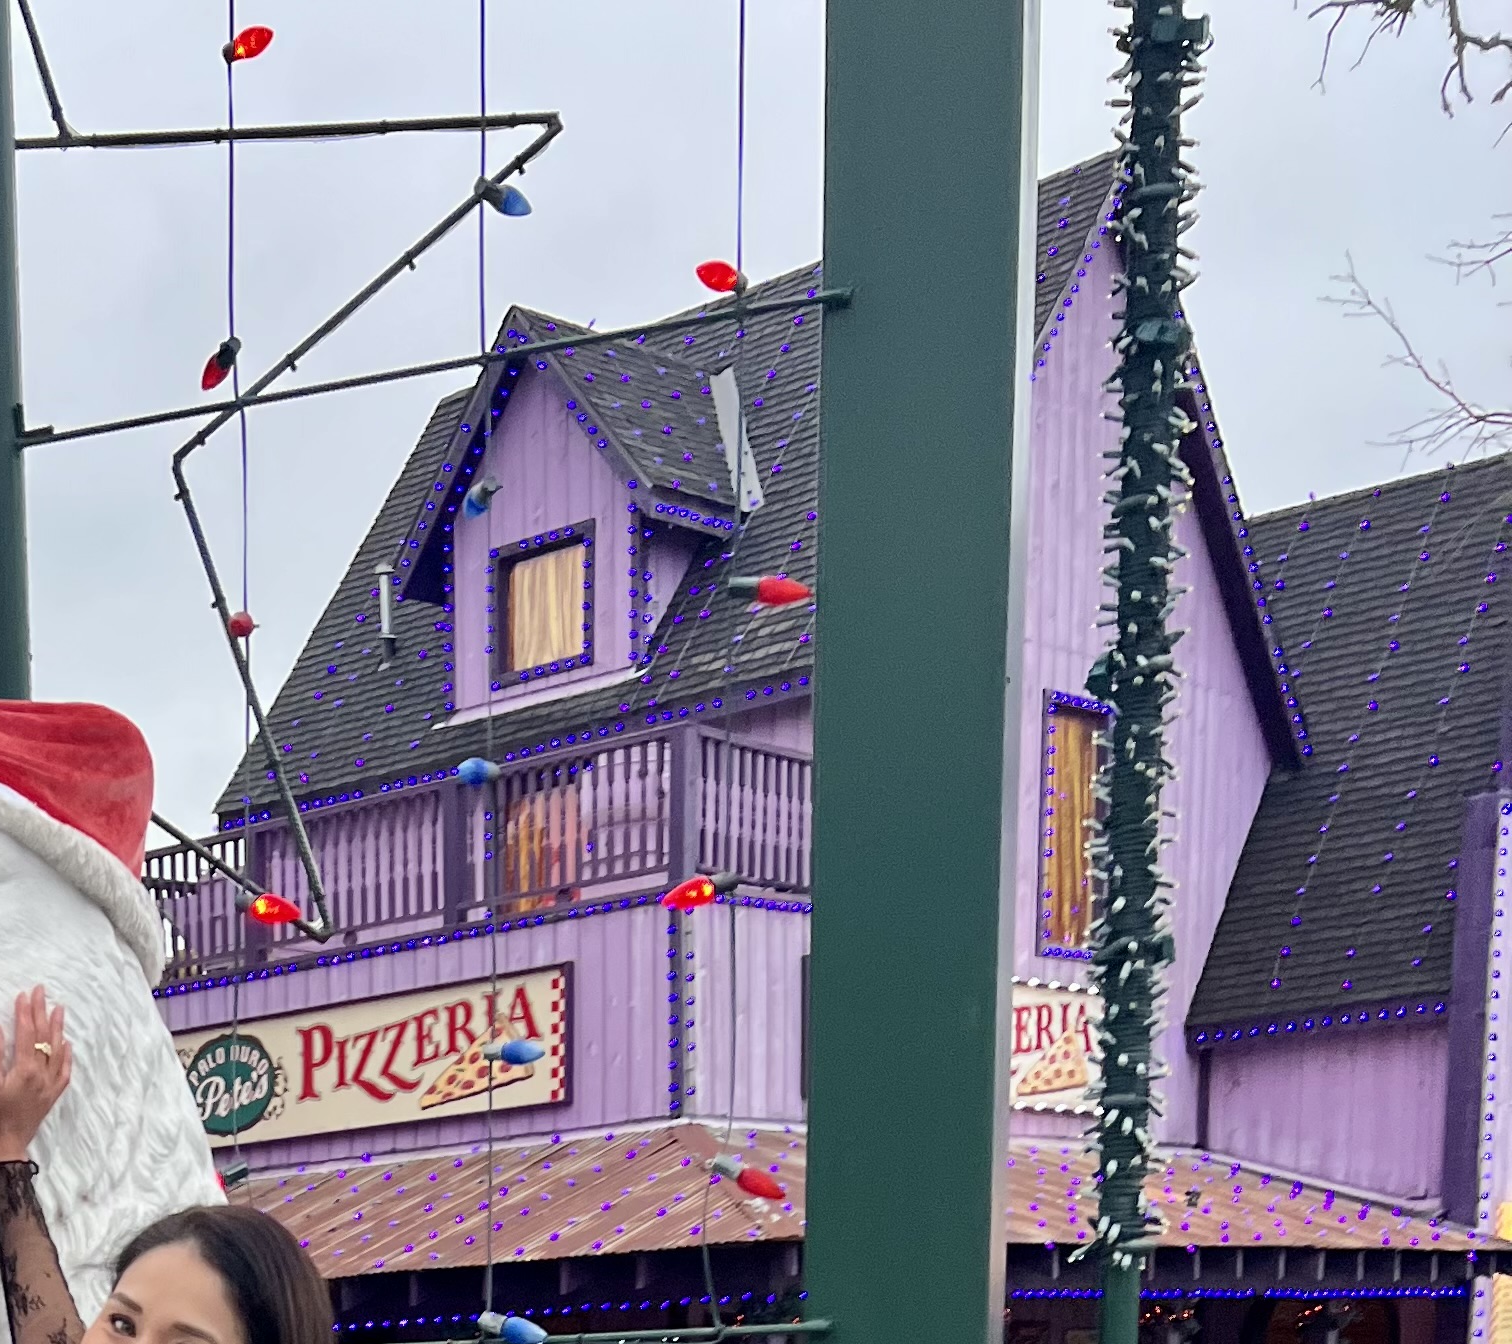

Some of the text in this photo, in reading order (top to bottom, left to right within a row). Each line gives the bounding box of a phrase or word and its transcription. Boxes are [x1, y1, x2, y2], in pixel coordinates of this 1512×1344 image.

[297, 984, 544, 1102] PIZZERIA
[1012, 1002, 1092, 1055] ERIA
[189, 1045, 269, 1087] PALO DURO
[195, 1074, 268, 1121] Pete's
